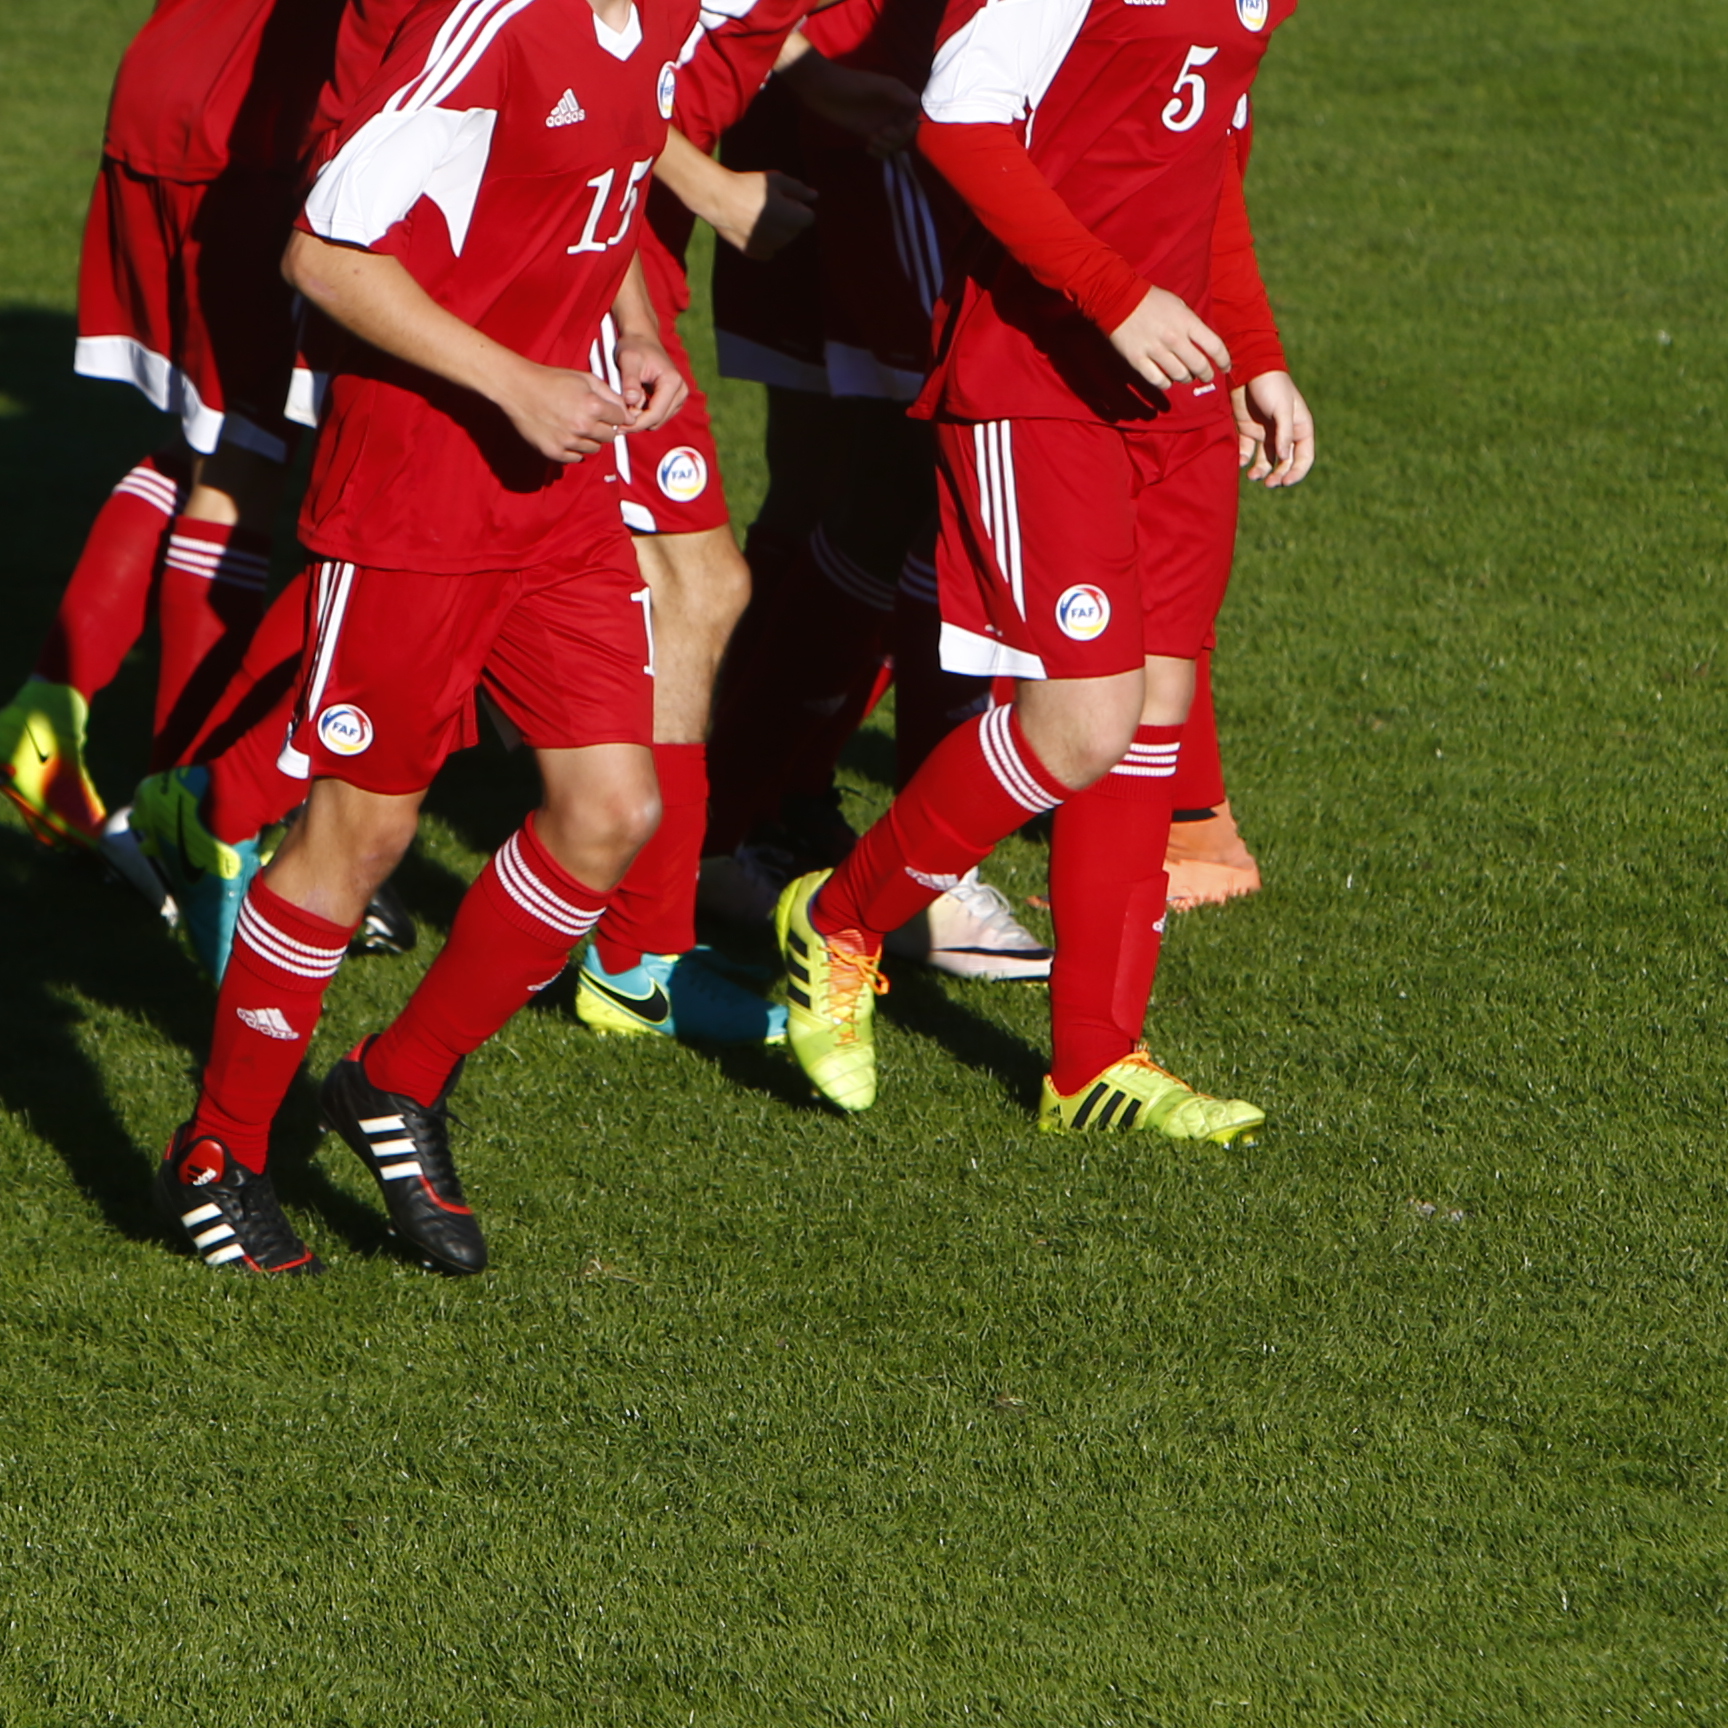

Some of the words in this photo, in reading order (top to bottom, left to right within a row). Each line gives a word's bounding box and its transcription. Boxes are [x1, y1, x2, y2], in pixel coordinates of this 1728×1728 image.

[1161, 44, 1219, 132] 5
[545, 108, 586, 128] adidas
[566, 154, 654, 255] 15
[672, 467, 693, 480] FAF
[1071, 607, 1095, 618] FAF
[332, 721, 359, 738] FAF
